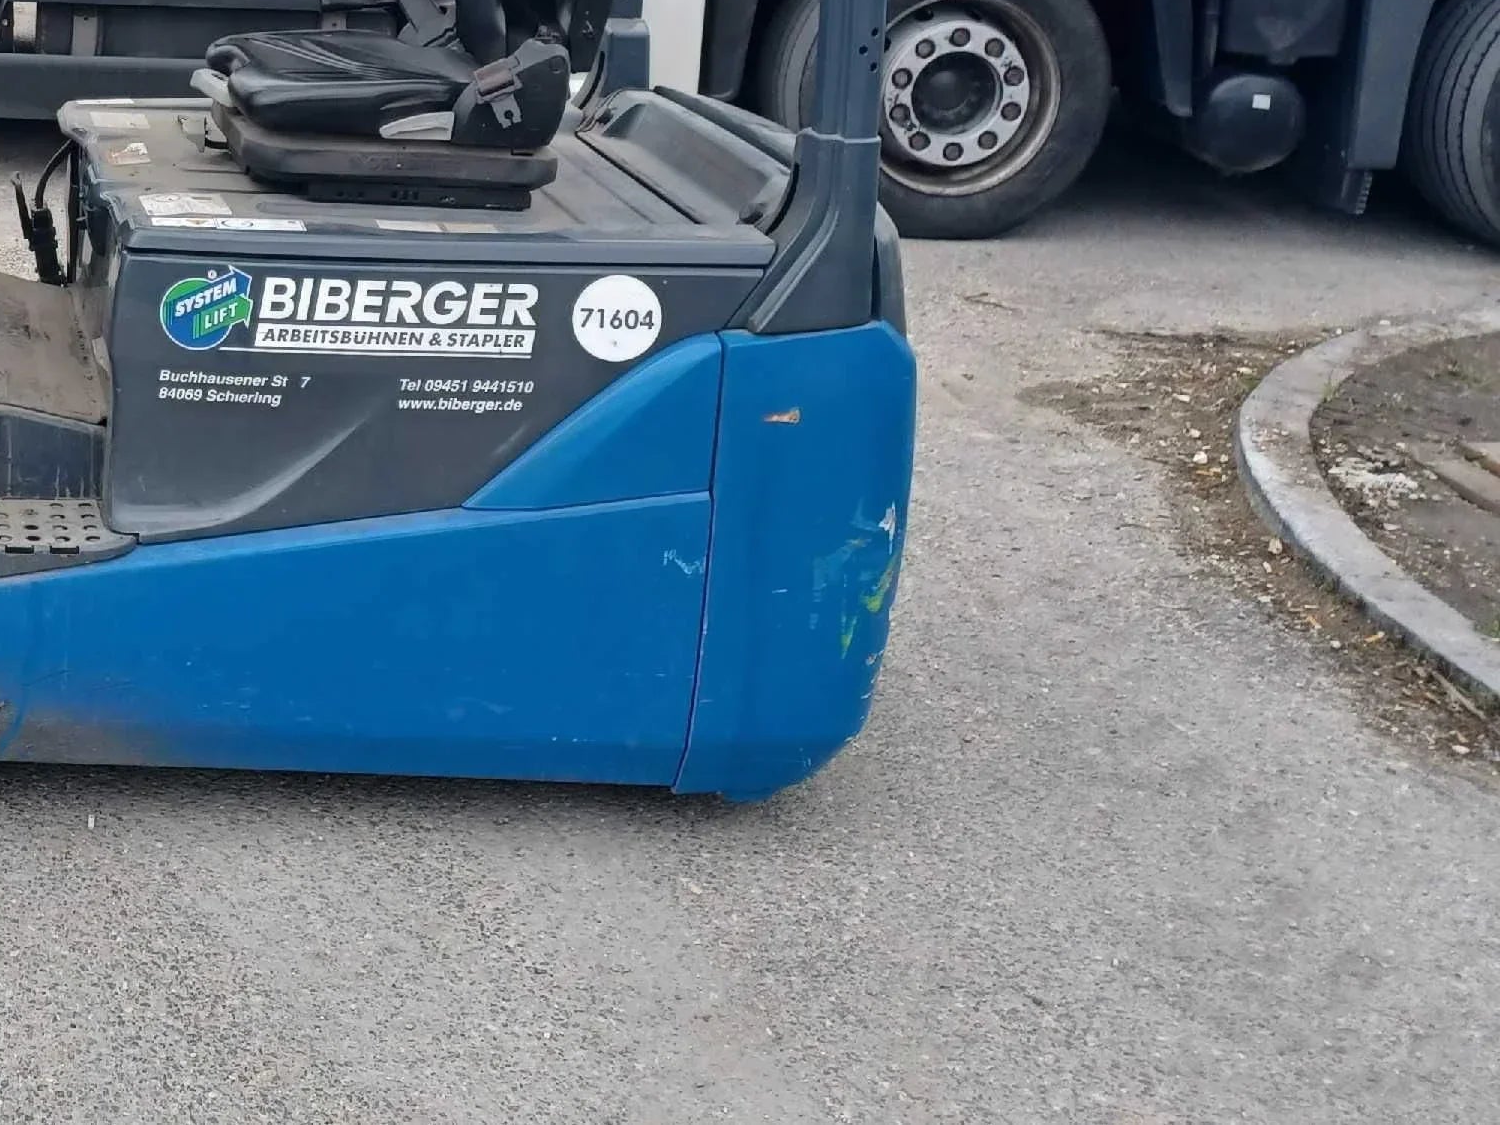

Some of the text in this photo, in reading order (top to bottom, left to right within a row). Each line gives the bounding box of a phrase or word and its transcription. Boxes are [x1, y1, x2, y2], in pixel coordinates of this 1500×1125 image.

[174, 277, 238, 318] SYSTEM
[258, 276, 540, 326] BIBERGER
[204, 302, 239, 329] LIFT
[580, 308, 654, 330] 71604
[262, 328, 525, 349] ARBEITSBÜHNEN & STAPLER
[159, 369, 269, 387] Buchhausener
[300, 376, 311, 388] 7
[400, 378, 535, 393] Tel 09451 9441510
[158, 386, 282, 408] 84069 Schierling
[399, 397, 523, 413] www.biberger.de
